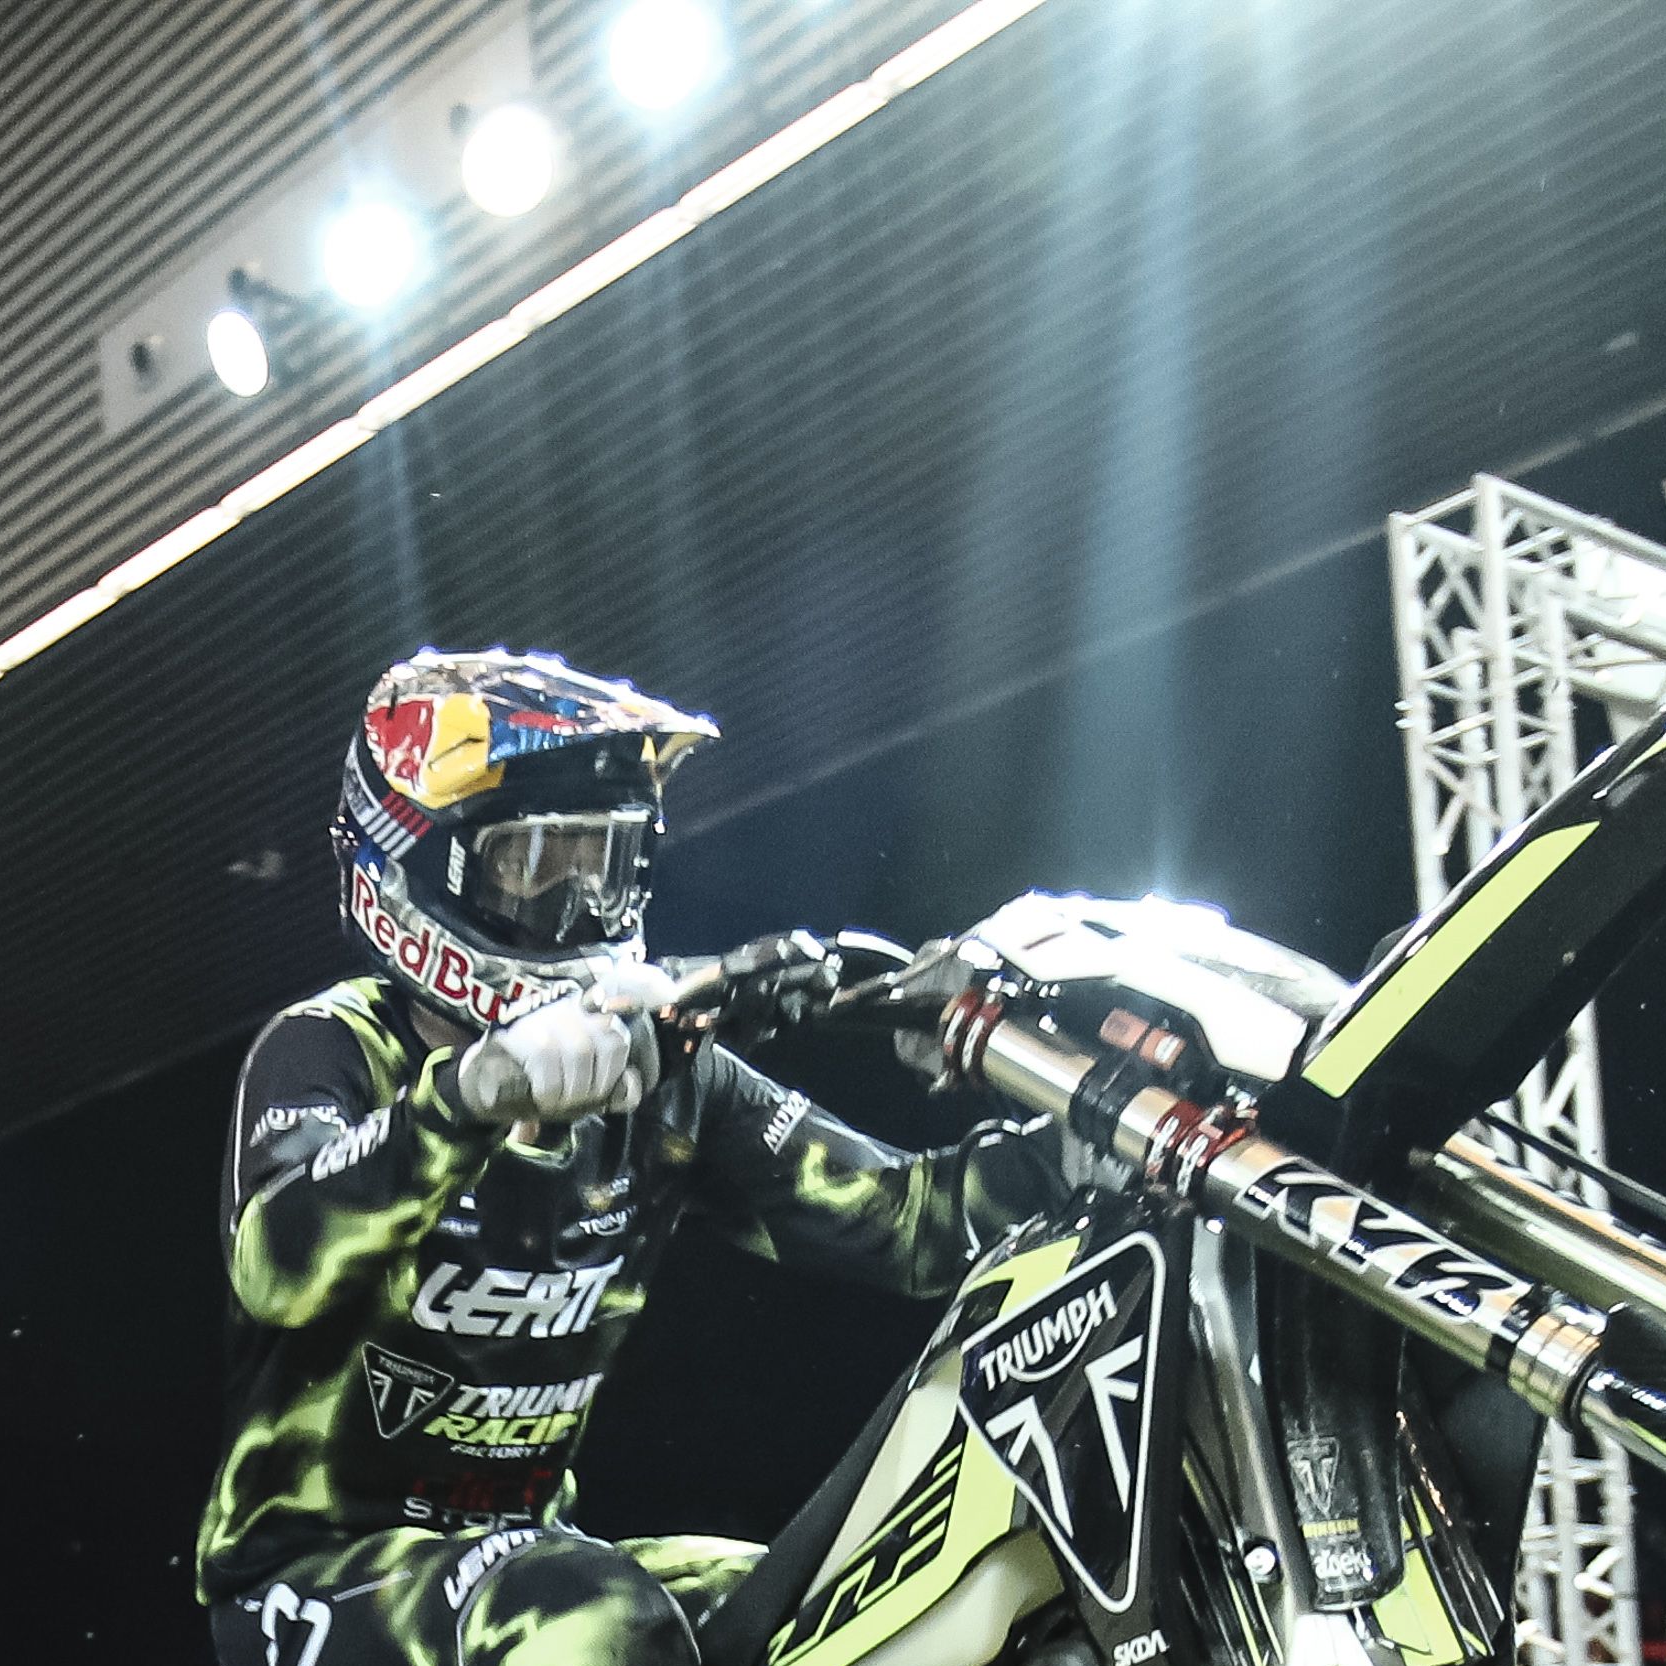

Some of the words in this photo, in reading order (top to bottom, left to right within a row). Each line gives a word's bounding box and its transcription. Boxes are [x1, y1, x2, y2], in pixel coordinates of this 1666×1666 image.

[352, 866, 431, 984] Red
[1233, 1155, 1523, 1326] KYB
[978, 1280, 1119, 1392] TRIUMPH
